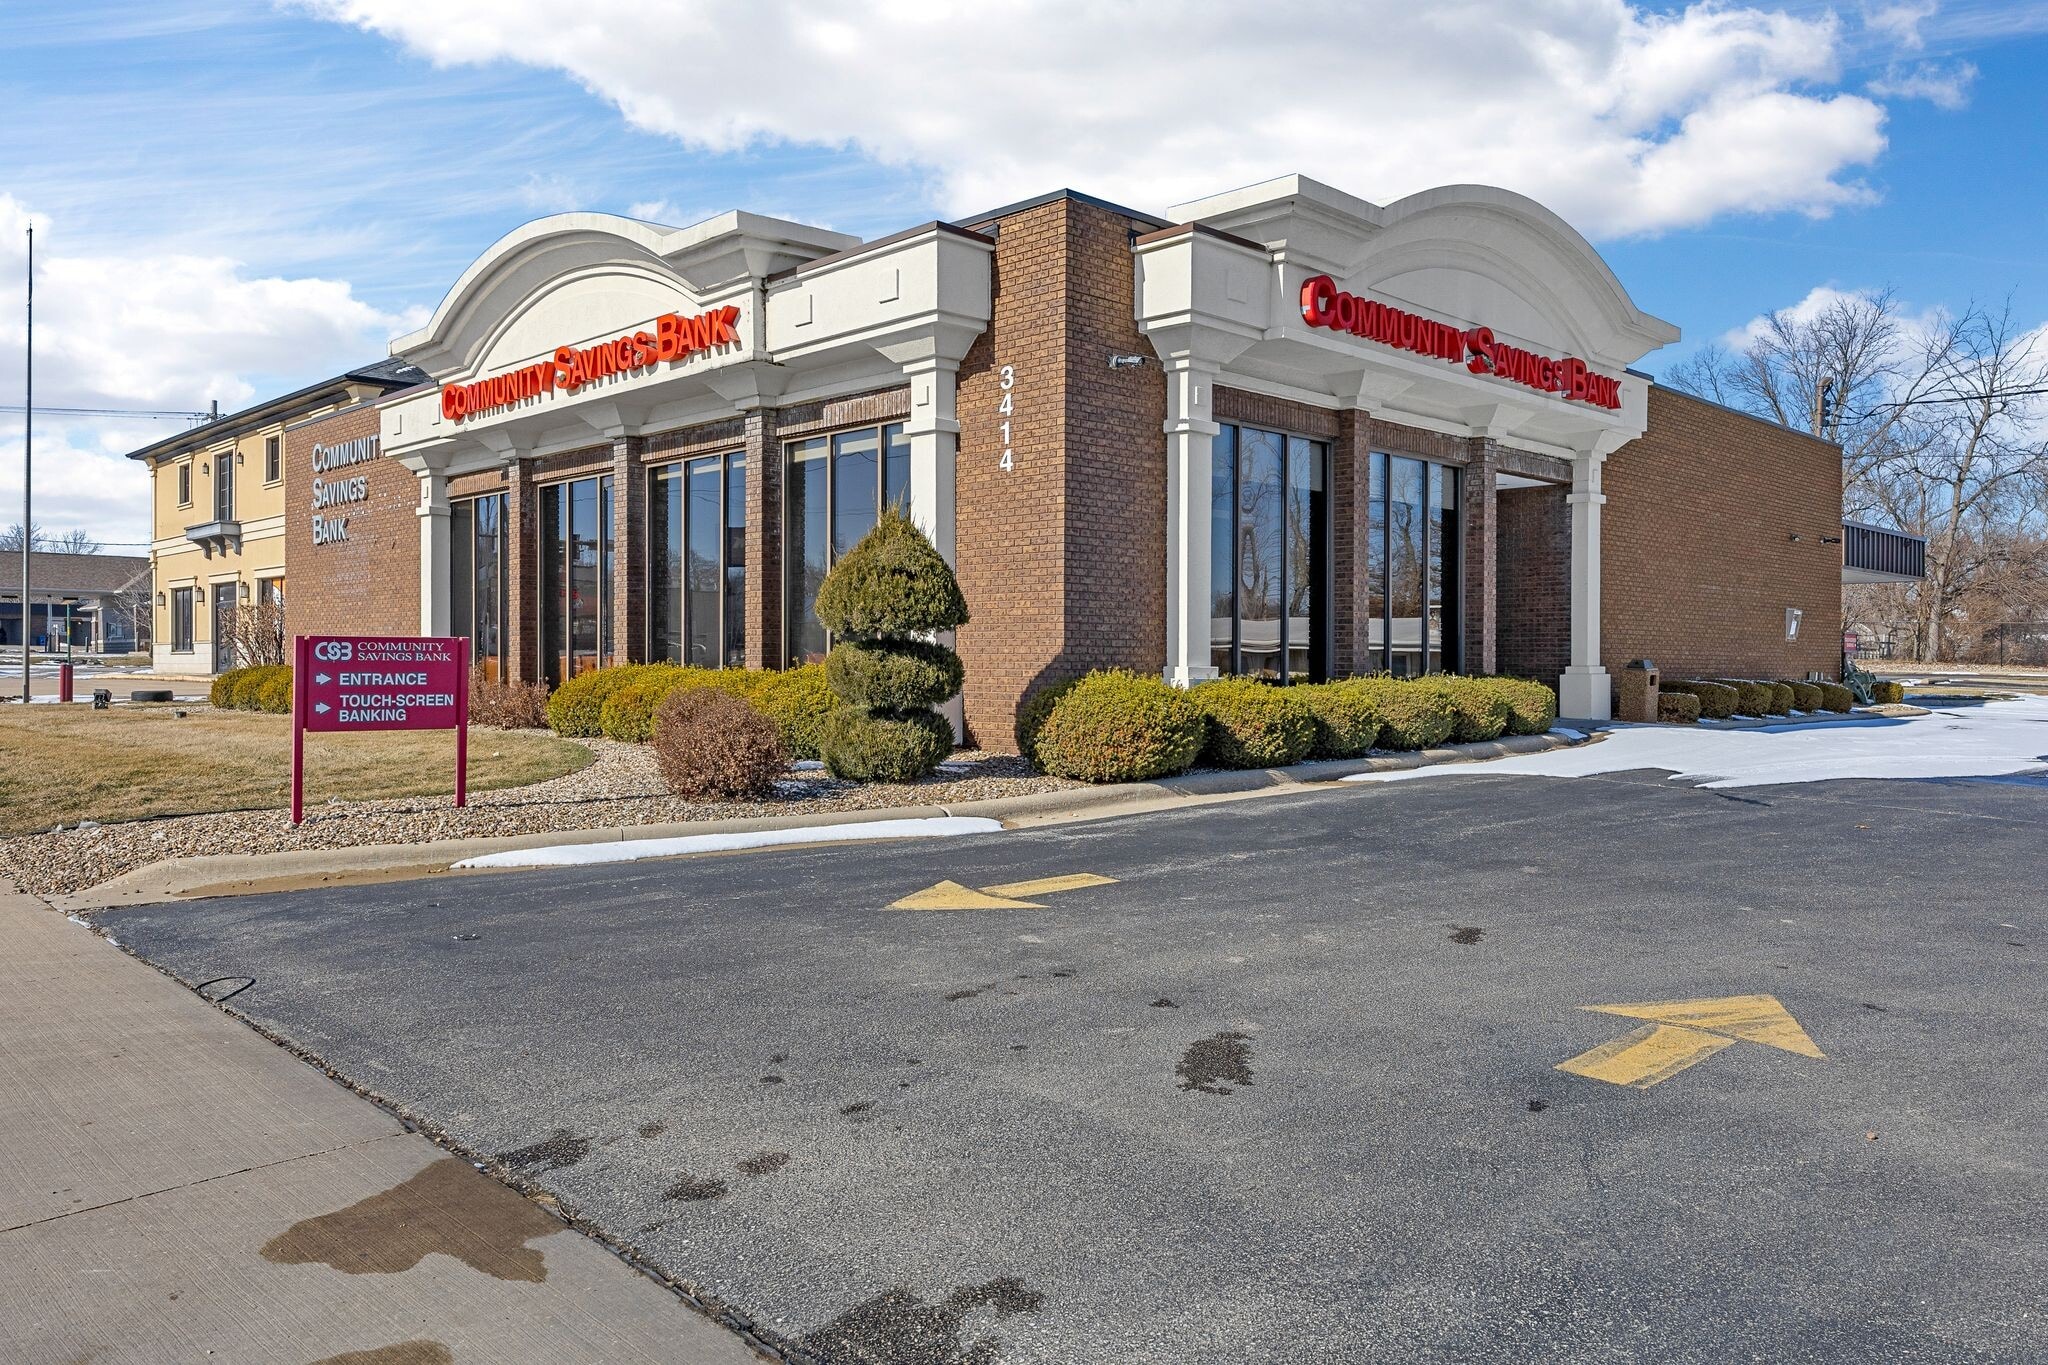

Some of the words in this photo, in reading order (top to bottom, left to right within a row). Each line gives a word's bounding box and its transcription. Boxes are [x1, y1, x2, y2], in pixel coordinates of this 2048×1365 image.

[1300, 275, 1467, 363] COMMUNITY
[1466, 327, 1565, 392] SAVINGS
[1563, 357, 1622, 409] BANK
[442, 361, 551, 420] COMMUNITY
[554, 331, 655, 390] SAVINGS
[656, 305, 741, 362] BANK
[999, 365, 1014, 472] 3414
[312, 434, 381, 472] COMMUNIT
[312, 475, 367, 509] SAVINGS
[312, 515, 348, 545] BANK
[357, 641, 445, 652] COMMUNITY
[357, 652, 413, 661] SAVINGS
[415, 652, 452, 662] BANK
[339, 673, 428, 686] ENTRANCE
[339, 709, 407, 722] BANKING
[340, 694, 454, 707] TOUCH-SCREEN
